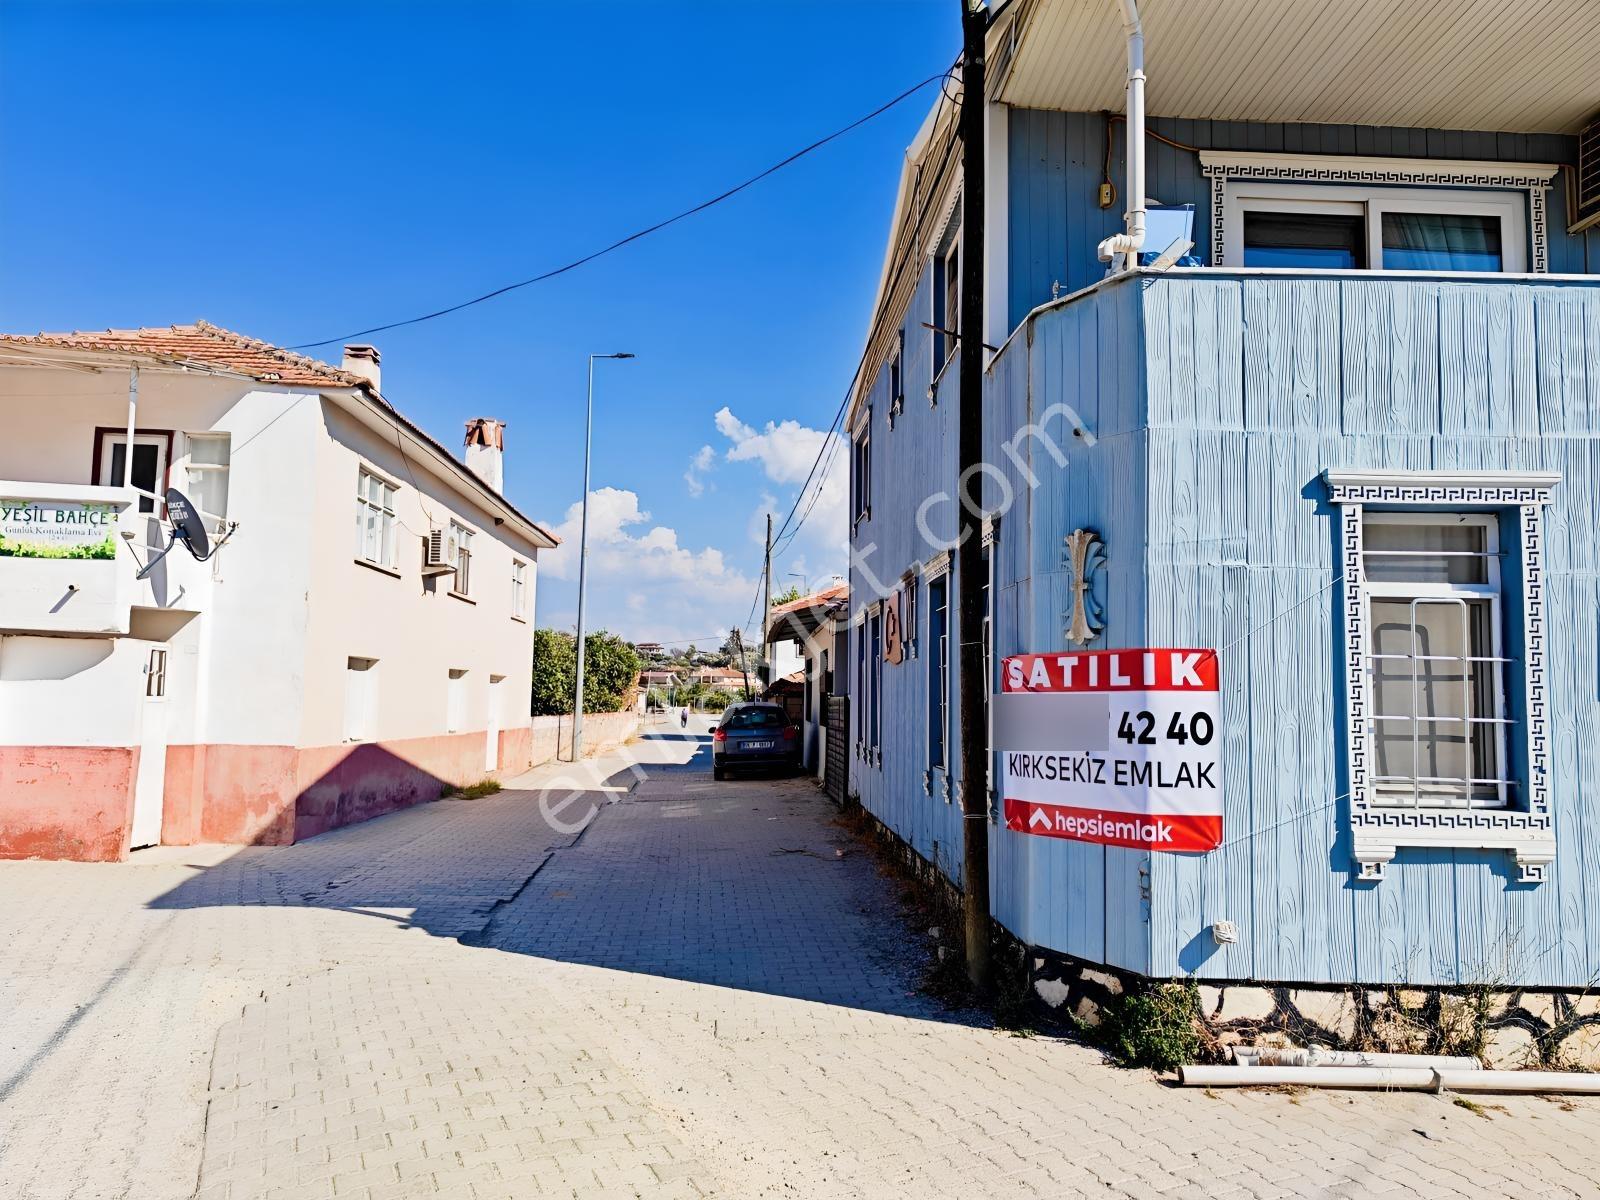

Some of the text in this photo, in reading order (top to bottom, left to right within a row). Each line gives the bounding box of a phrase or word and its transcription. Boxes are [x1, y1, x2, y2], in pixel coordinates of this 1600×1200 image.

[2, 505, 109, 528] YEŞİL BAHÇE
[1008, 652, 1204, 688] SATILIK
[1117, 711, 1214, 746] 42 40
[1009, 751, 1216, 789] KIRKSEKİZ EMLAK
[1055, 811, 1173, 842] hepsiemlak
